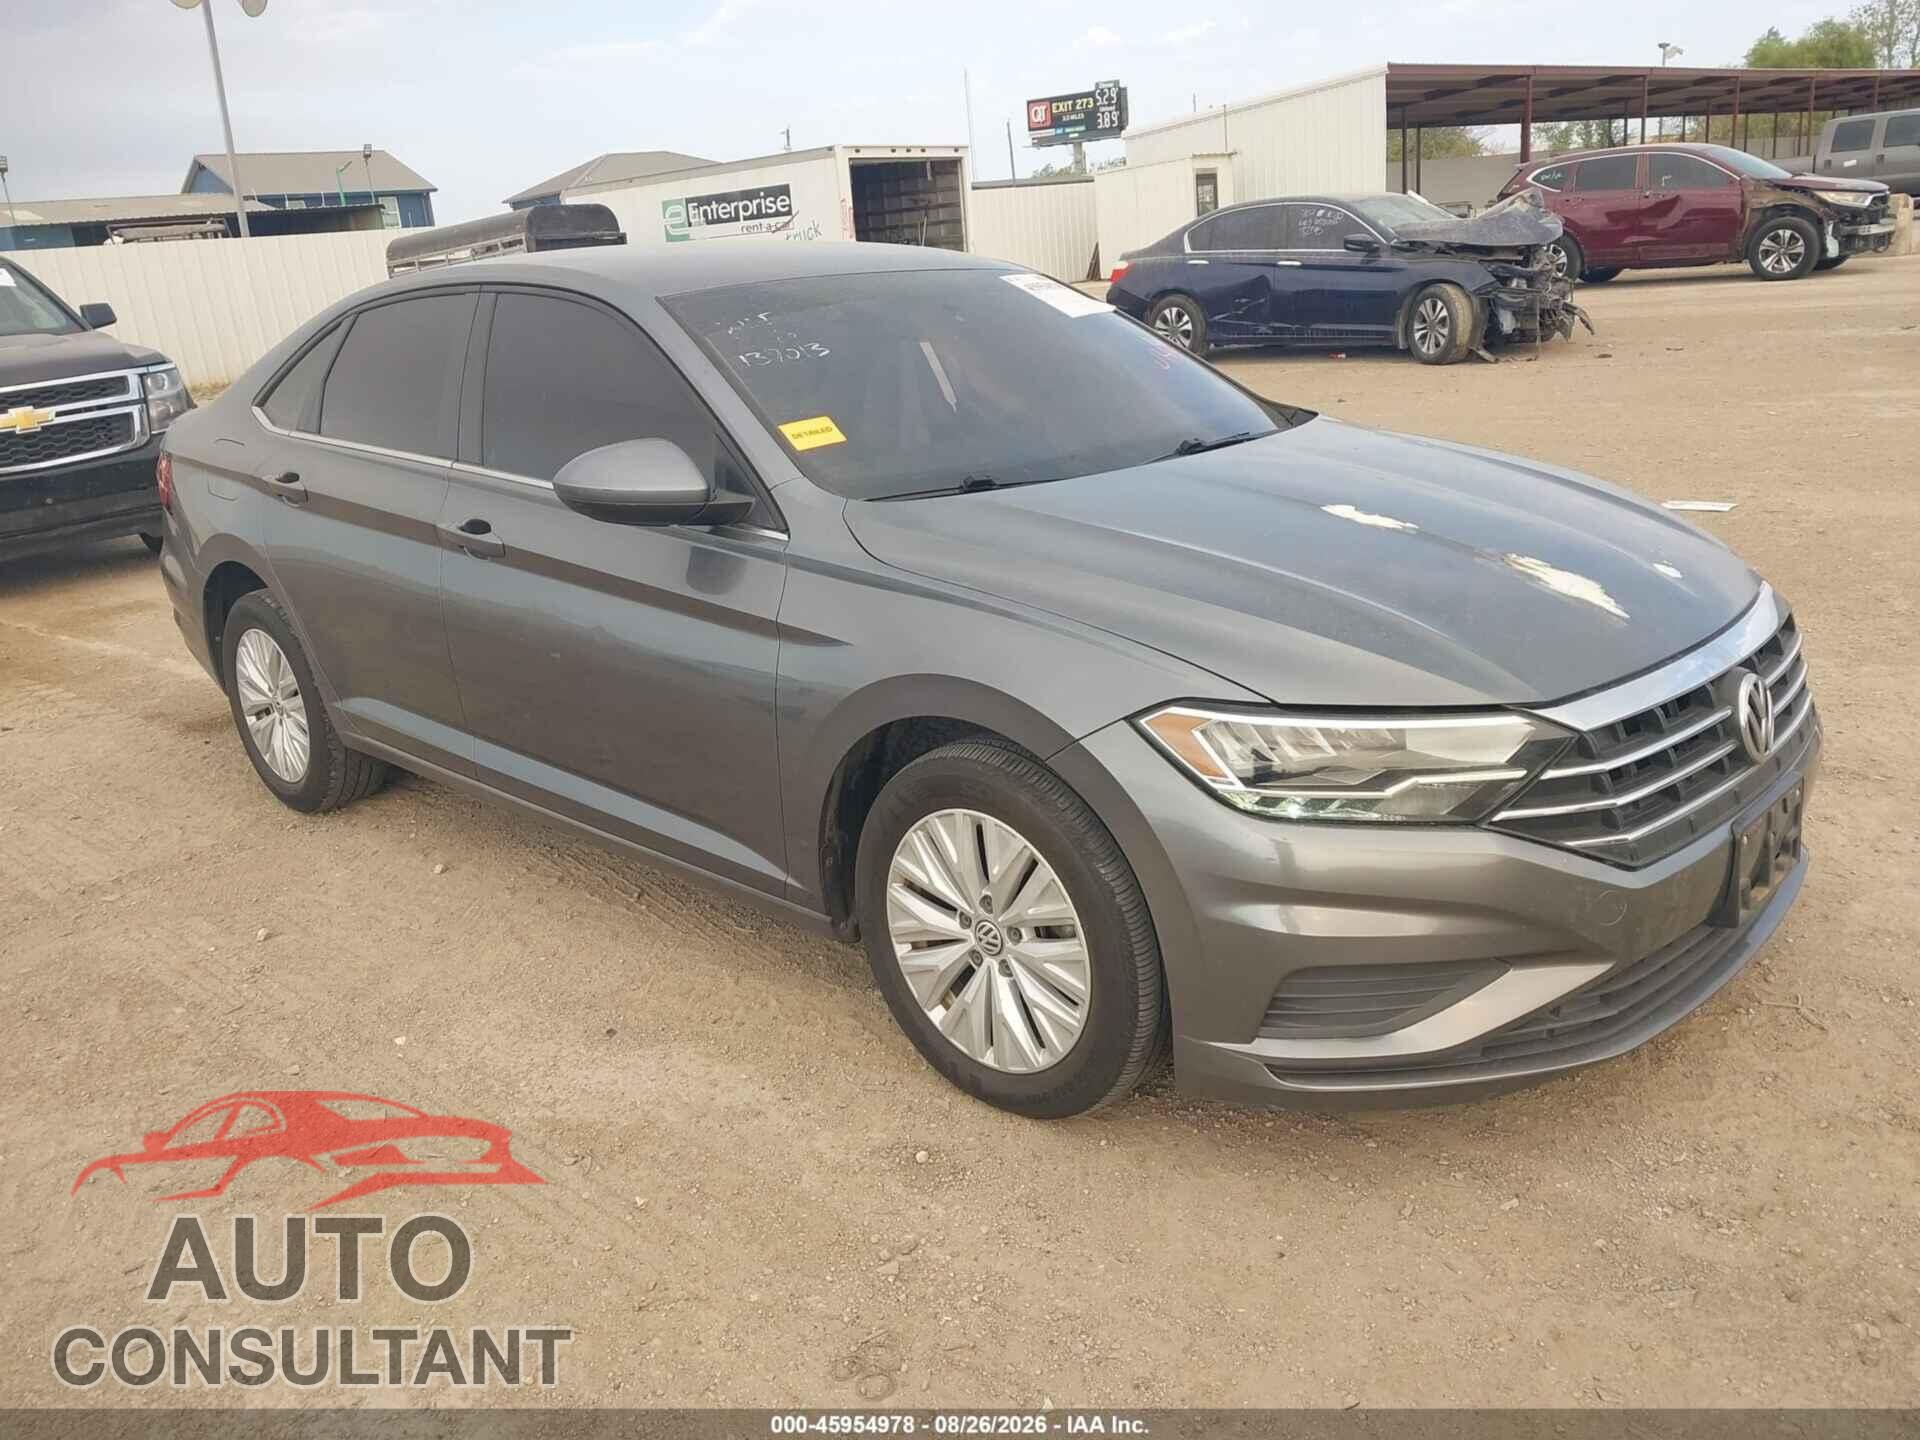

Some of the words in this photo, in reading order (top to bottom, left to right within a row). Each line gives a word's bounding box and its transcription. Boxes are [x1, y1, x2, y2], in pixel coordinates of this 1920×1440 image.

[1051, 100, 1073, 113] EXIT
[1075, 97, 1094, 110] 273
[687, 191, 791, 223] Enterprise
